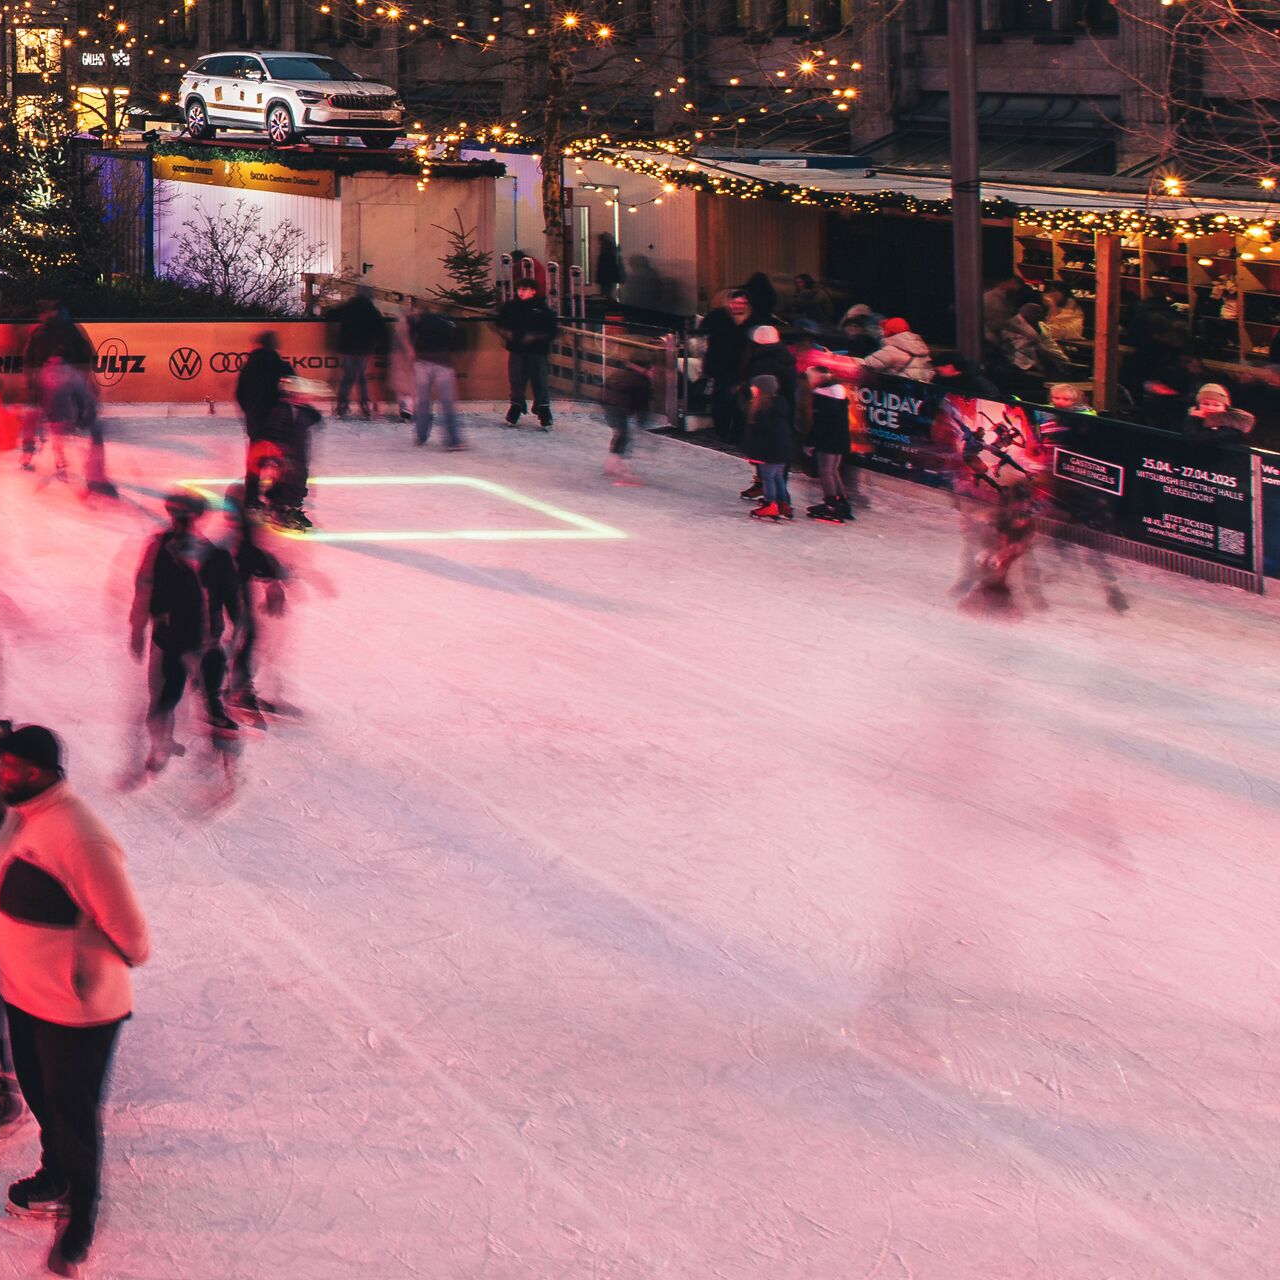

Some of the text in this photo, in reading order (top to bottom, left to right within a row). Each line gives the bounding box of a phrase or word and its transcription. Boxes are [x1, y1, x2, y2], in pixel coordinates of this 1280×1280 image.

[868, 406, 900, 428] ICE
[1070, 457, 1107, 473] GASTSTAR
[1142, 457, 1173, 473] 25.04.
[1181, 466, 1238, 487] 27.04.2025
[1088, 470, 1116, 485] ENGELS
[1136, 469, 1245, 500] MITSUBISHI ELECTRIC HALLE
[1163, 485, 1215, 503] DÜSSELDORF
[1184, 518, 1215, 532] TICKETS
